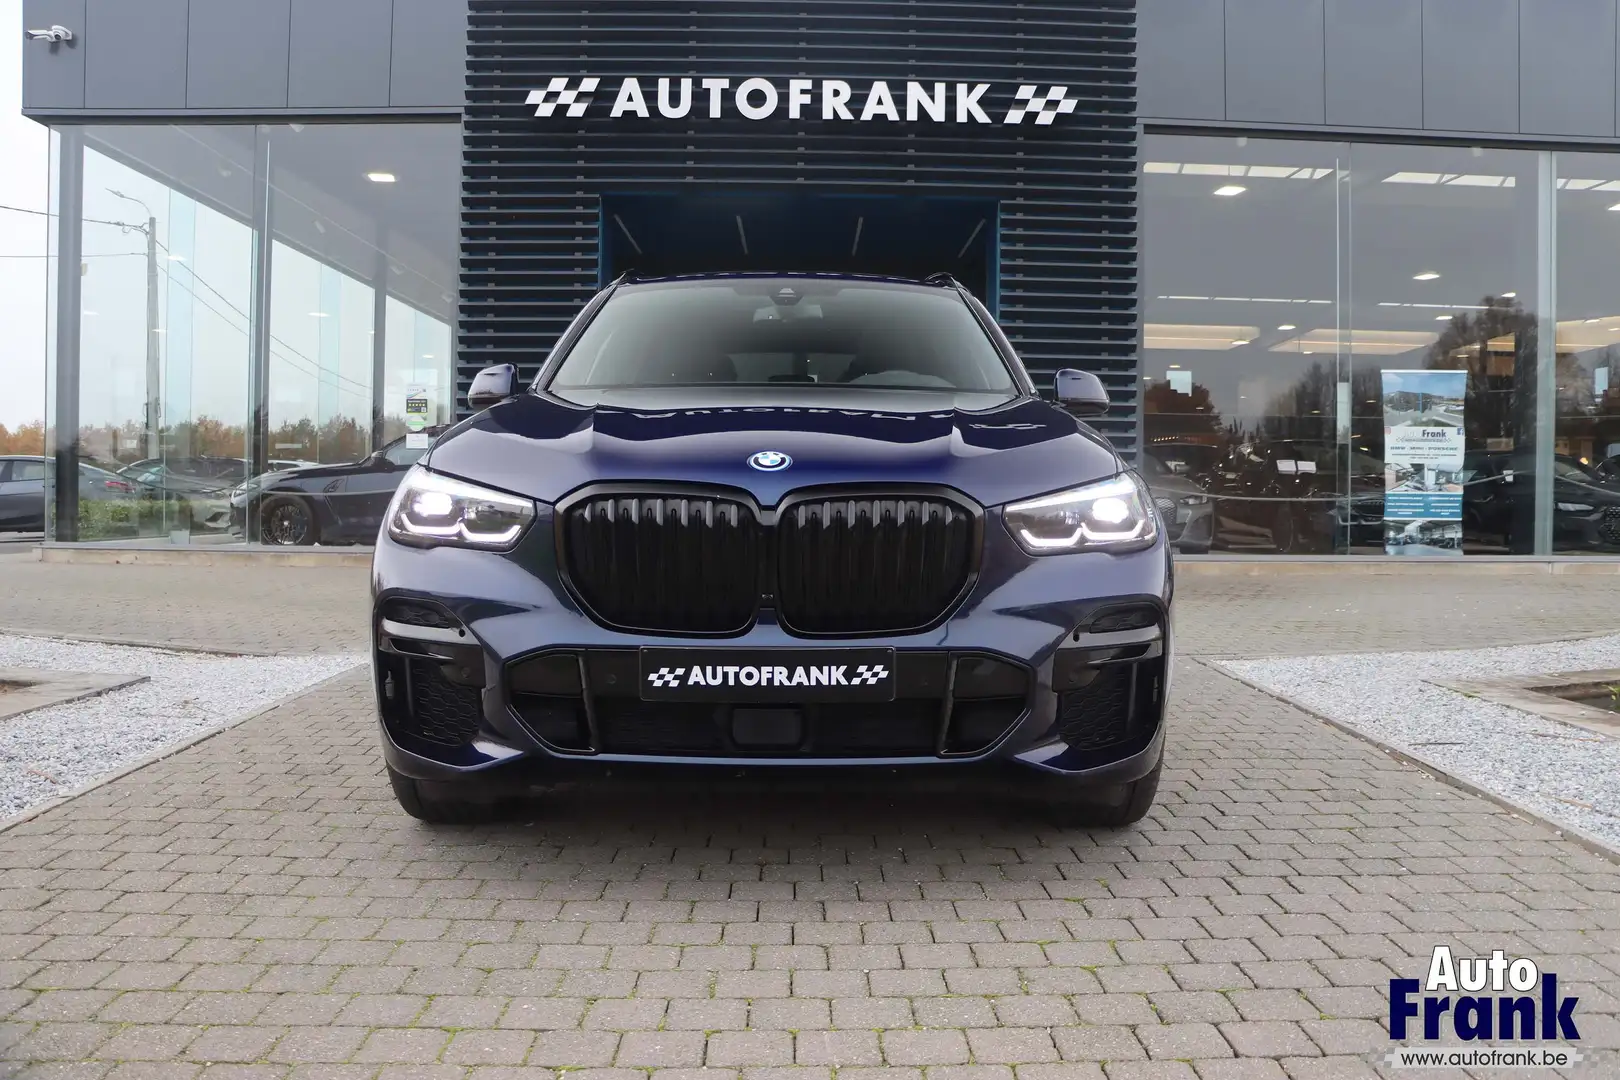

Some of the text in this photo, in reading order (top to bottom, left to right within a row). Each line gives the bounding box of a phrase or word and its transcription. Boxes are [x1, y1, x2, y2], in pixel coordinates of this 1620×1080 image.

[609, 78, 993, 124] AUTOFRANK
[1422, 429, 1447, 438] Frank
[687, 665, 849, 686] AUTOFRANK
